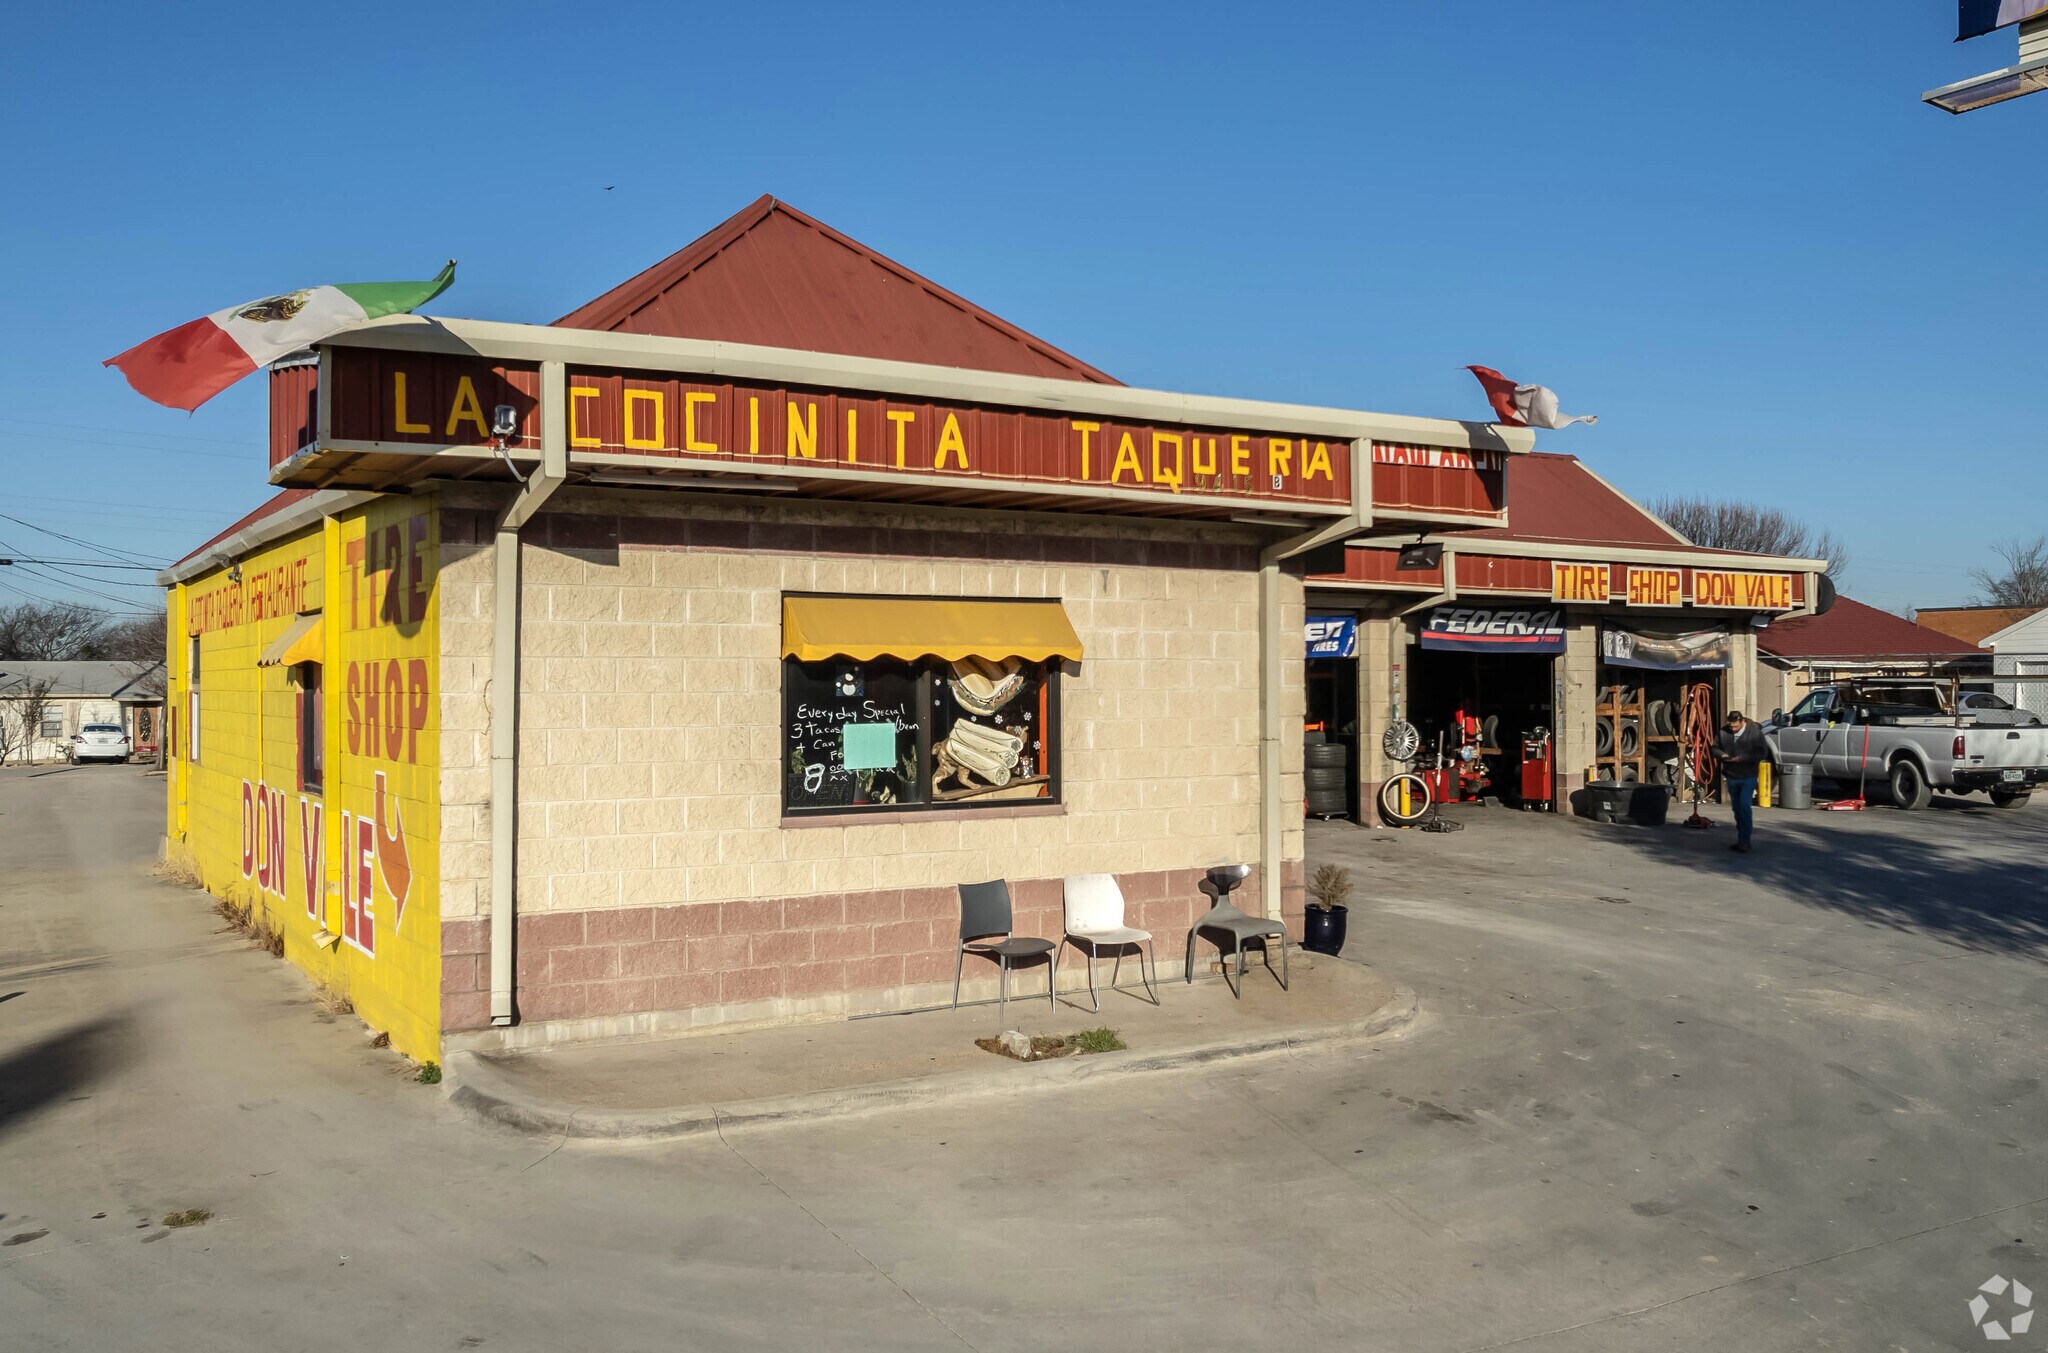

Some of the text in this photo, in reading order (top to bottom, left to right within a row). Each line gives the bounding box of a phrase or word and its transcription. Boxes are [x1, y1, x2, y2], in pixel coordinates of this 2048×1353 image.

[395, 371, 1334, 493] LA COCINITA TAQUERIA
[346, 515, 428, 630] TIRE
[1555, 564, 1790, 608] TIRE SHOP DON VALE
[1430, 607, 1565, 635] FEDERAL
[347, 659, 429, 764] SHOP
[790, 723, 803, 739] 3
[863, 700, 905, 720] Special
[803, 763, 825, 794] 8
[242, 778, 375, 959] DON VLE
